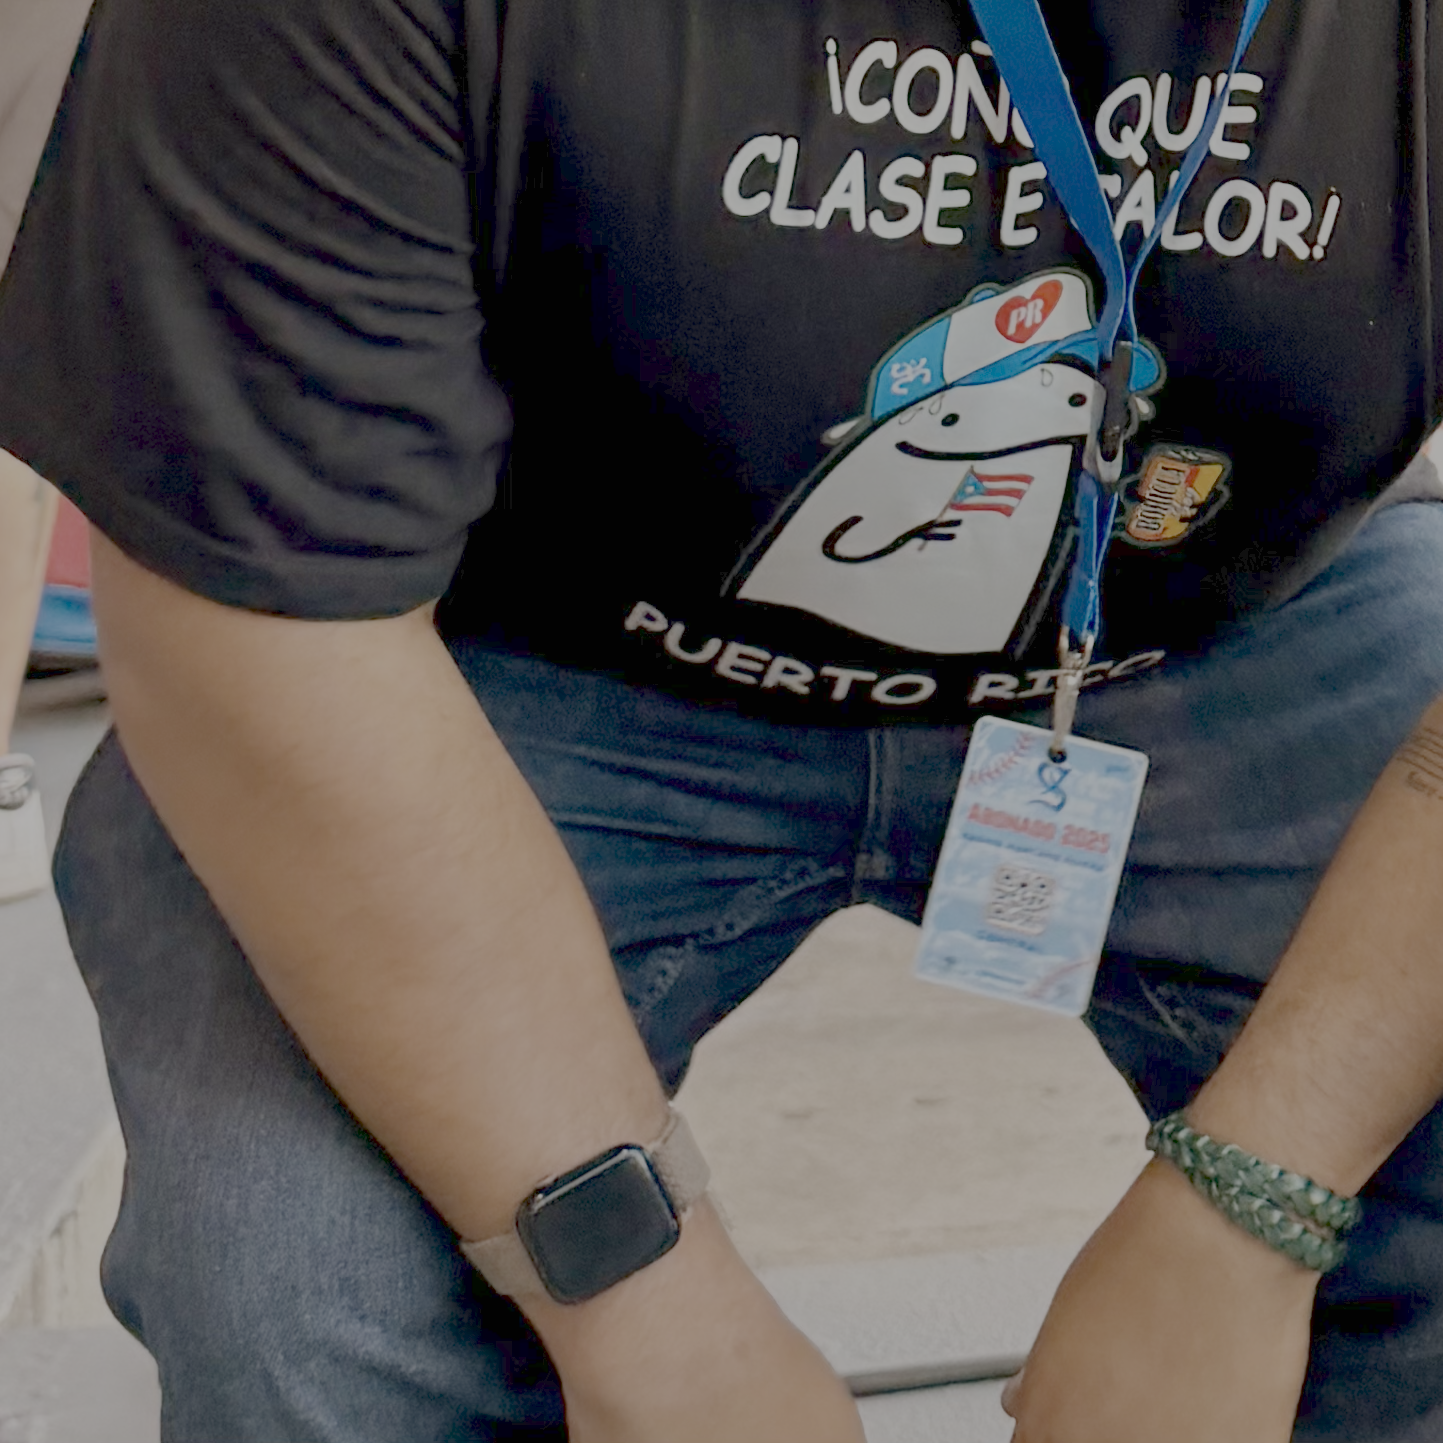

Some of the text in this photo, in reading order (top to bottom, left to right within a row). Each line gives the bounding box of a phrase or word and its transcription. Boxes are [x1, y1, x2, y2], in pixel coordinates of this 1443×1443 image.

[1094, 71, 1264, 167] QUE
[722, 134, 978, 245] CLASE
[1007, 298, 1045, 337] PR
[623, 600, 938, 706] PUERTO
